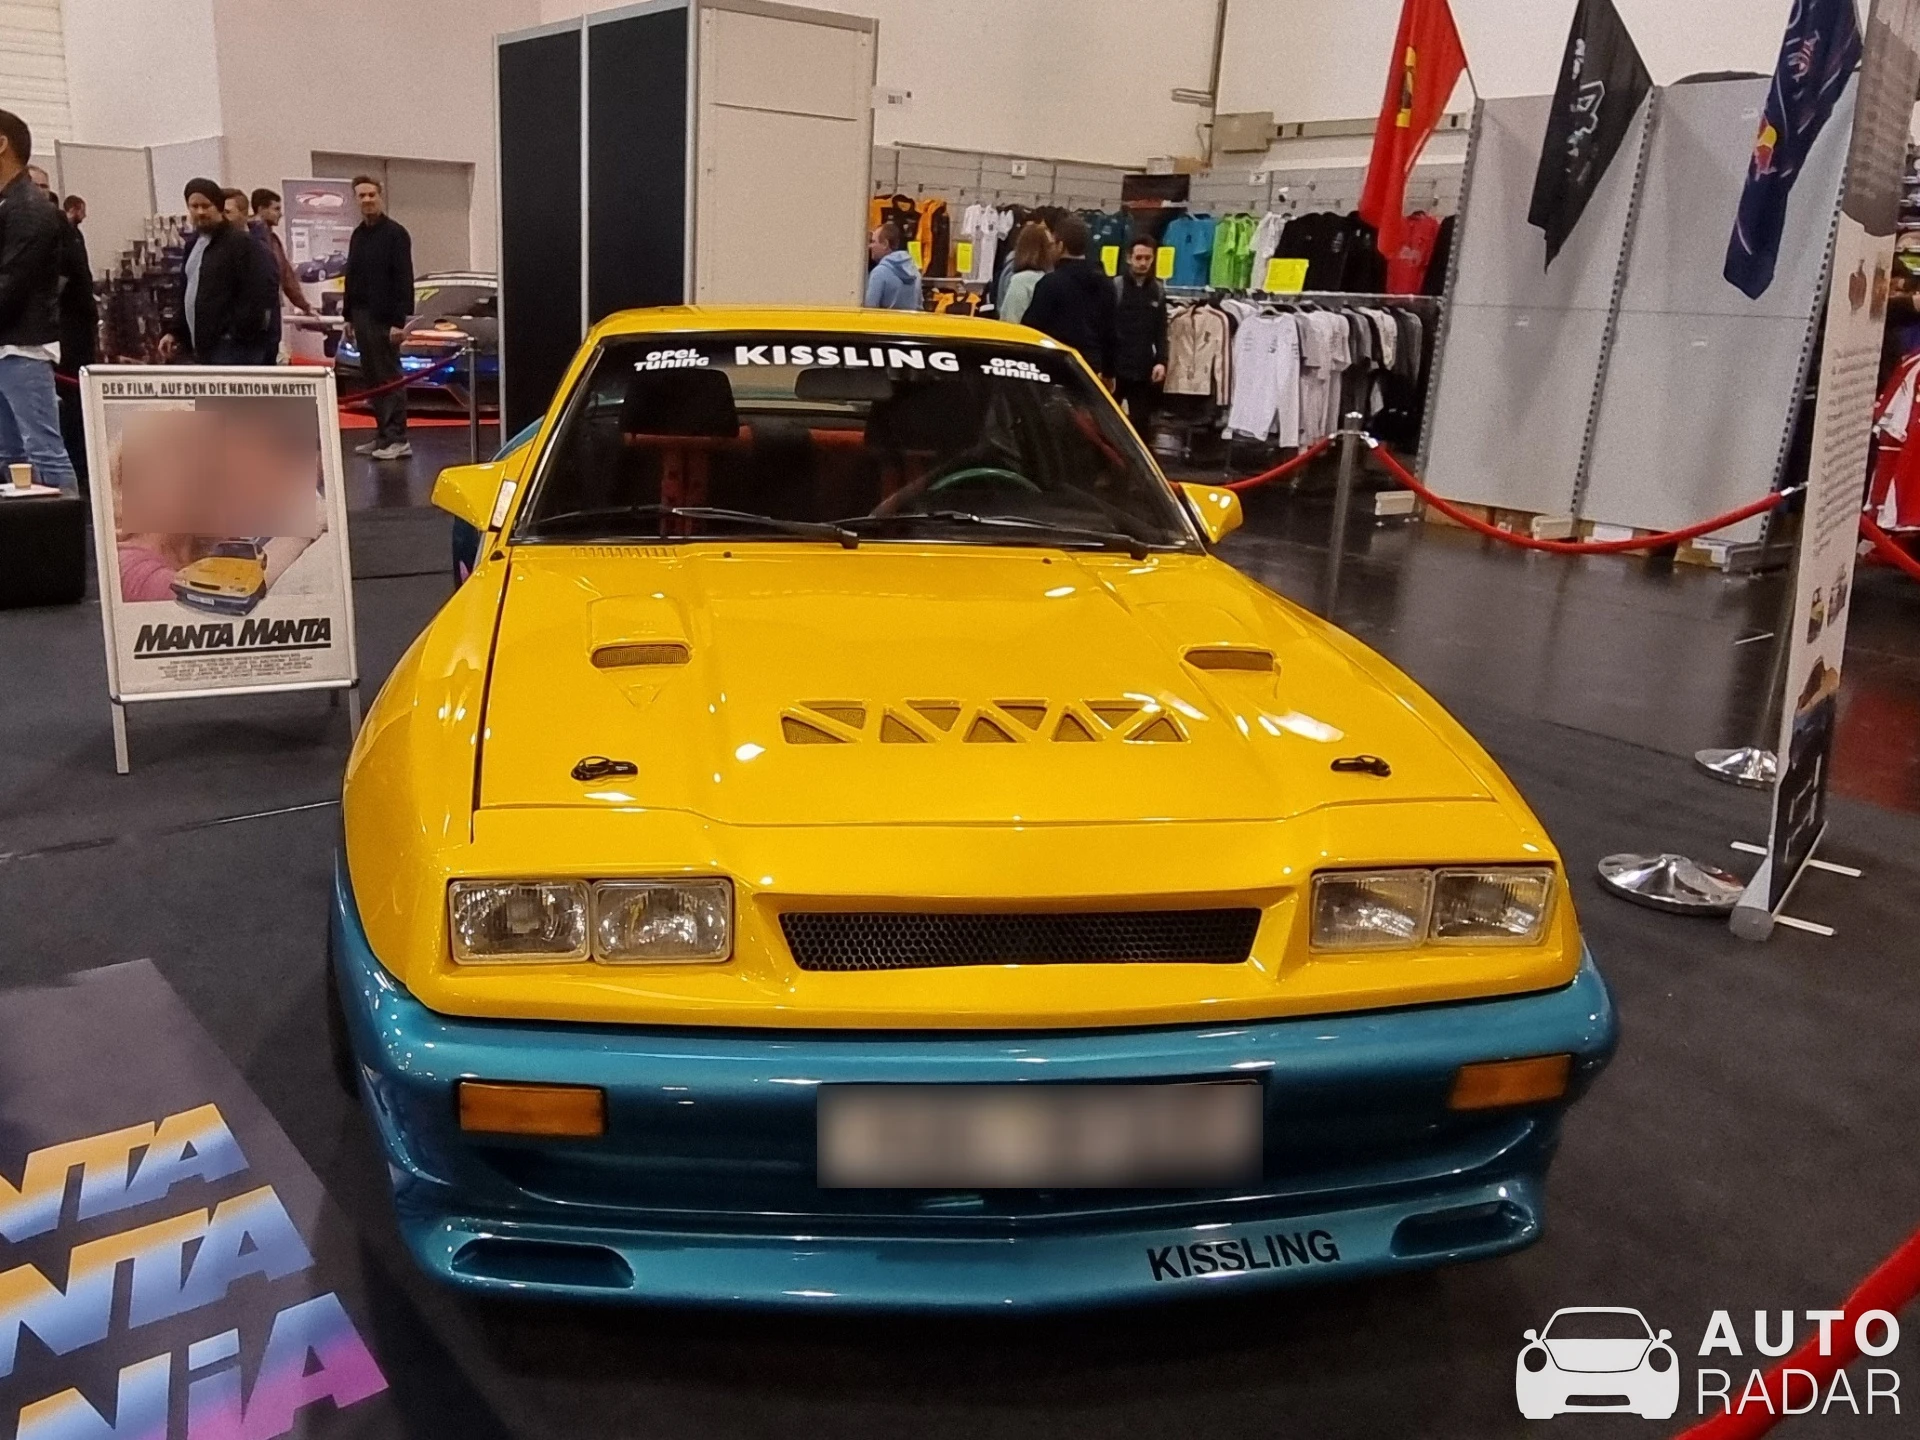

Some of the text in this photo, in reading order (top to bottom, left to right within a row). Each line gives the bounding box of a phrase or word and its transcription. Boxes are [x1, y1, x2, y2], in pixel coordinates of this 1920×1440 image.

[735, 345, 960, 372] KISSLING
[101, 382, 317, 397] DER FILM, AUF DEN DIE NATION WARTET!
[134, 617, 331, 653] MANTA MANTA
[1146, 1229, 1341, 1282] KISSLING
